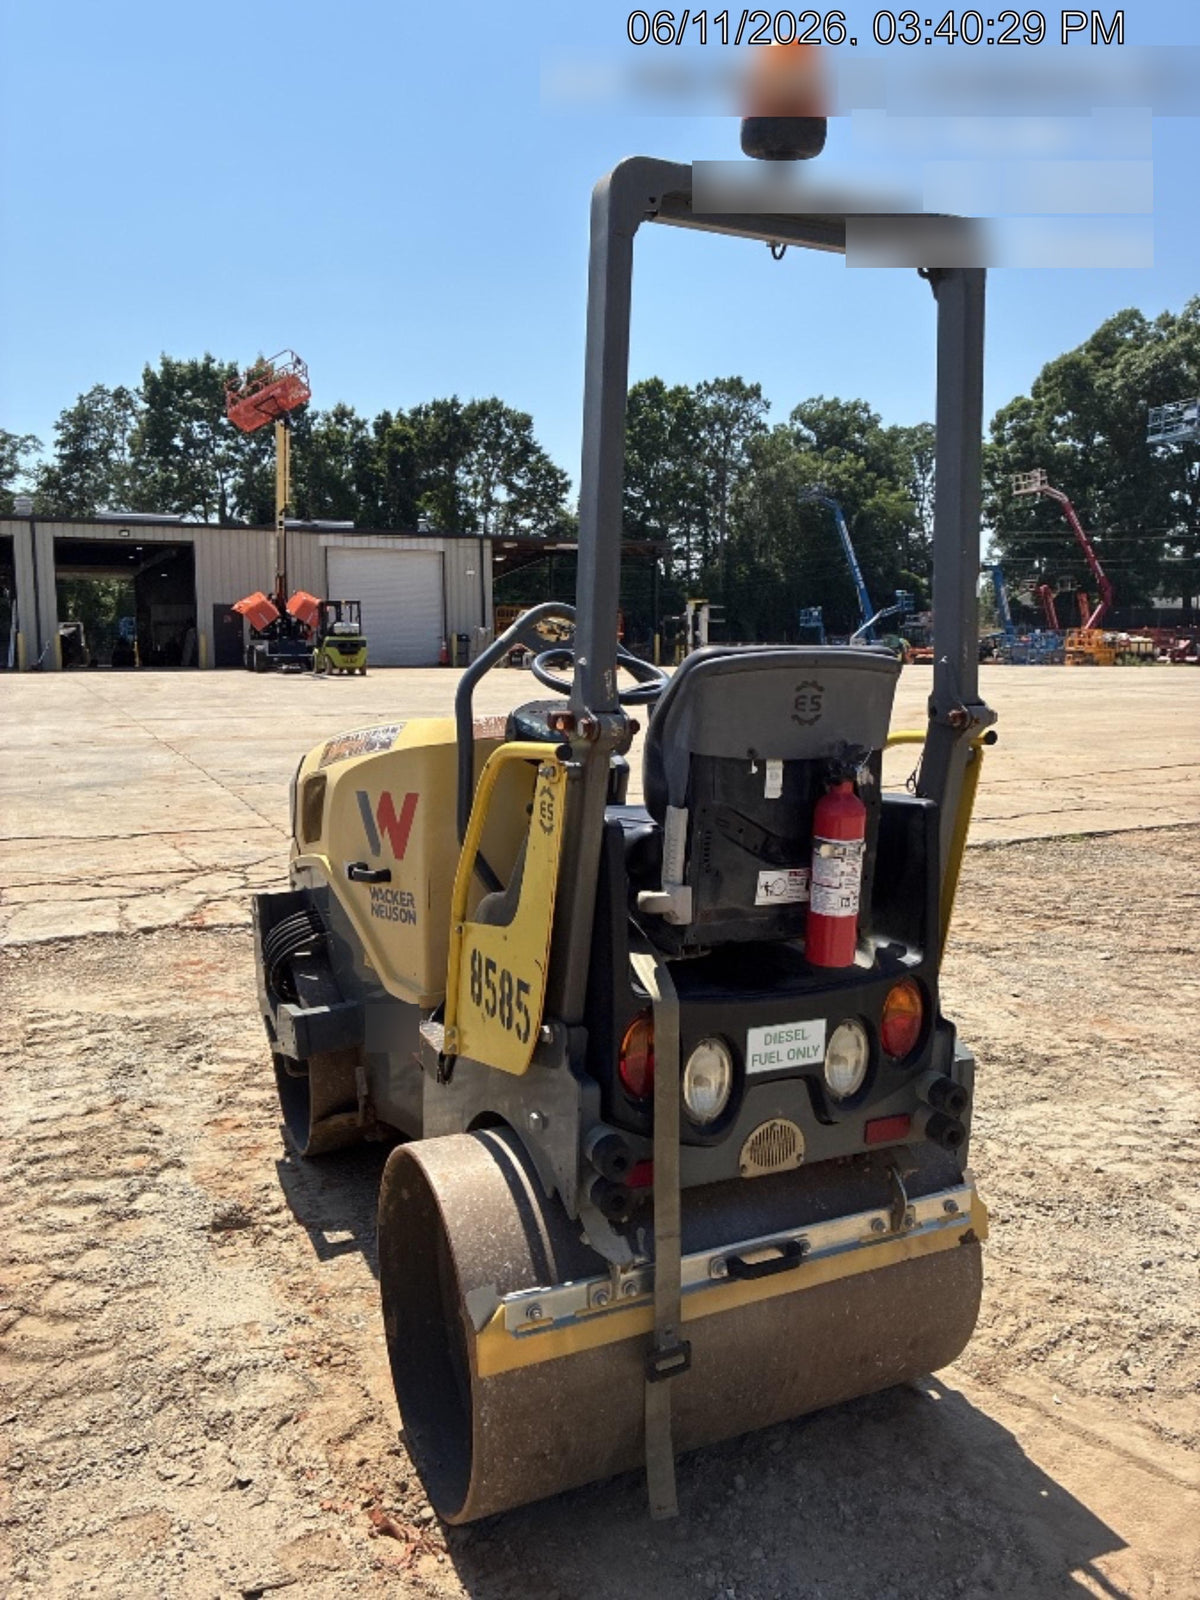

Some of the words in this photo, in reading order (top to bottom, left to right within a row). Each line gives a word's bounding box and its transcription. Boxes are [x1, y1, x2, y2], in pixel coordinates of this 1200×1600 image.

[369, 886, 416, 909] WACKER
[371, 902, 417, 926] NEUSON
[470, 947, 531, 1044] 8585
[764, 1028, 809, 1046] DIESEL
[751, 1050, 784, 1067] FUEL
[787, 1044, 820, 1060] ONLY
